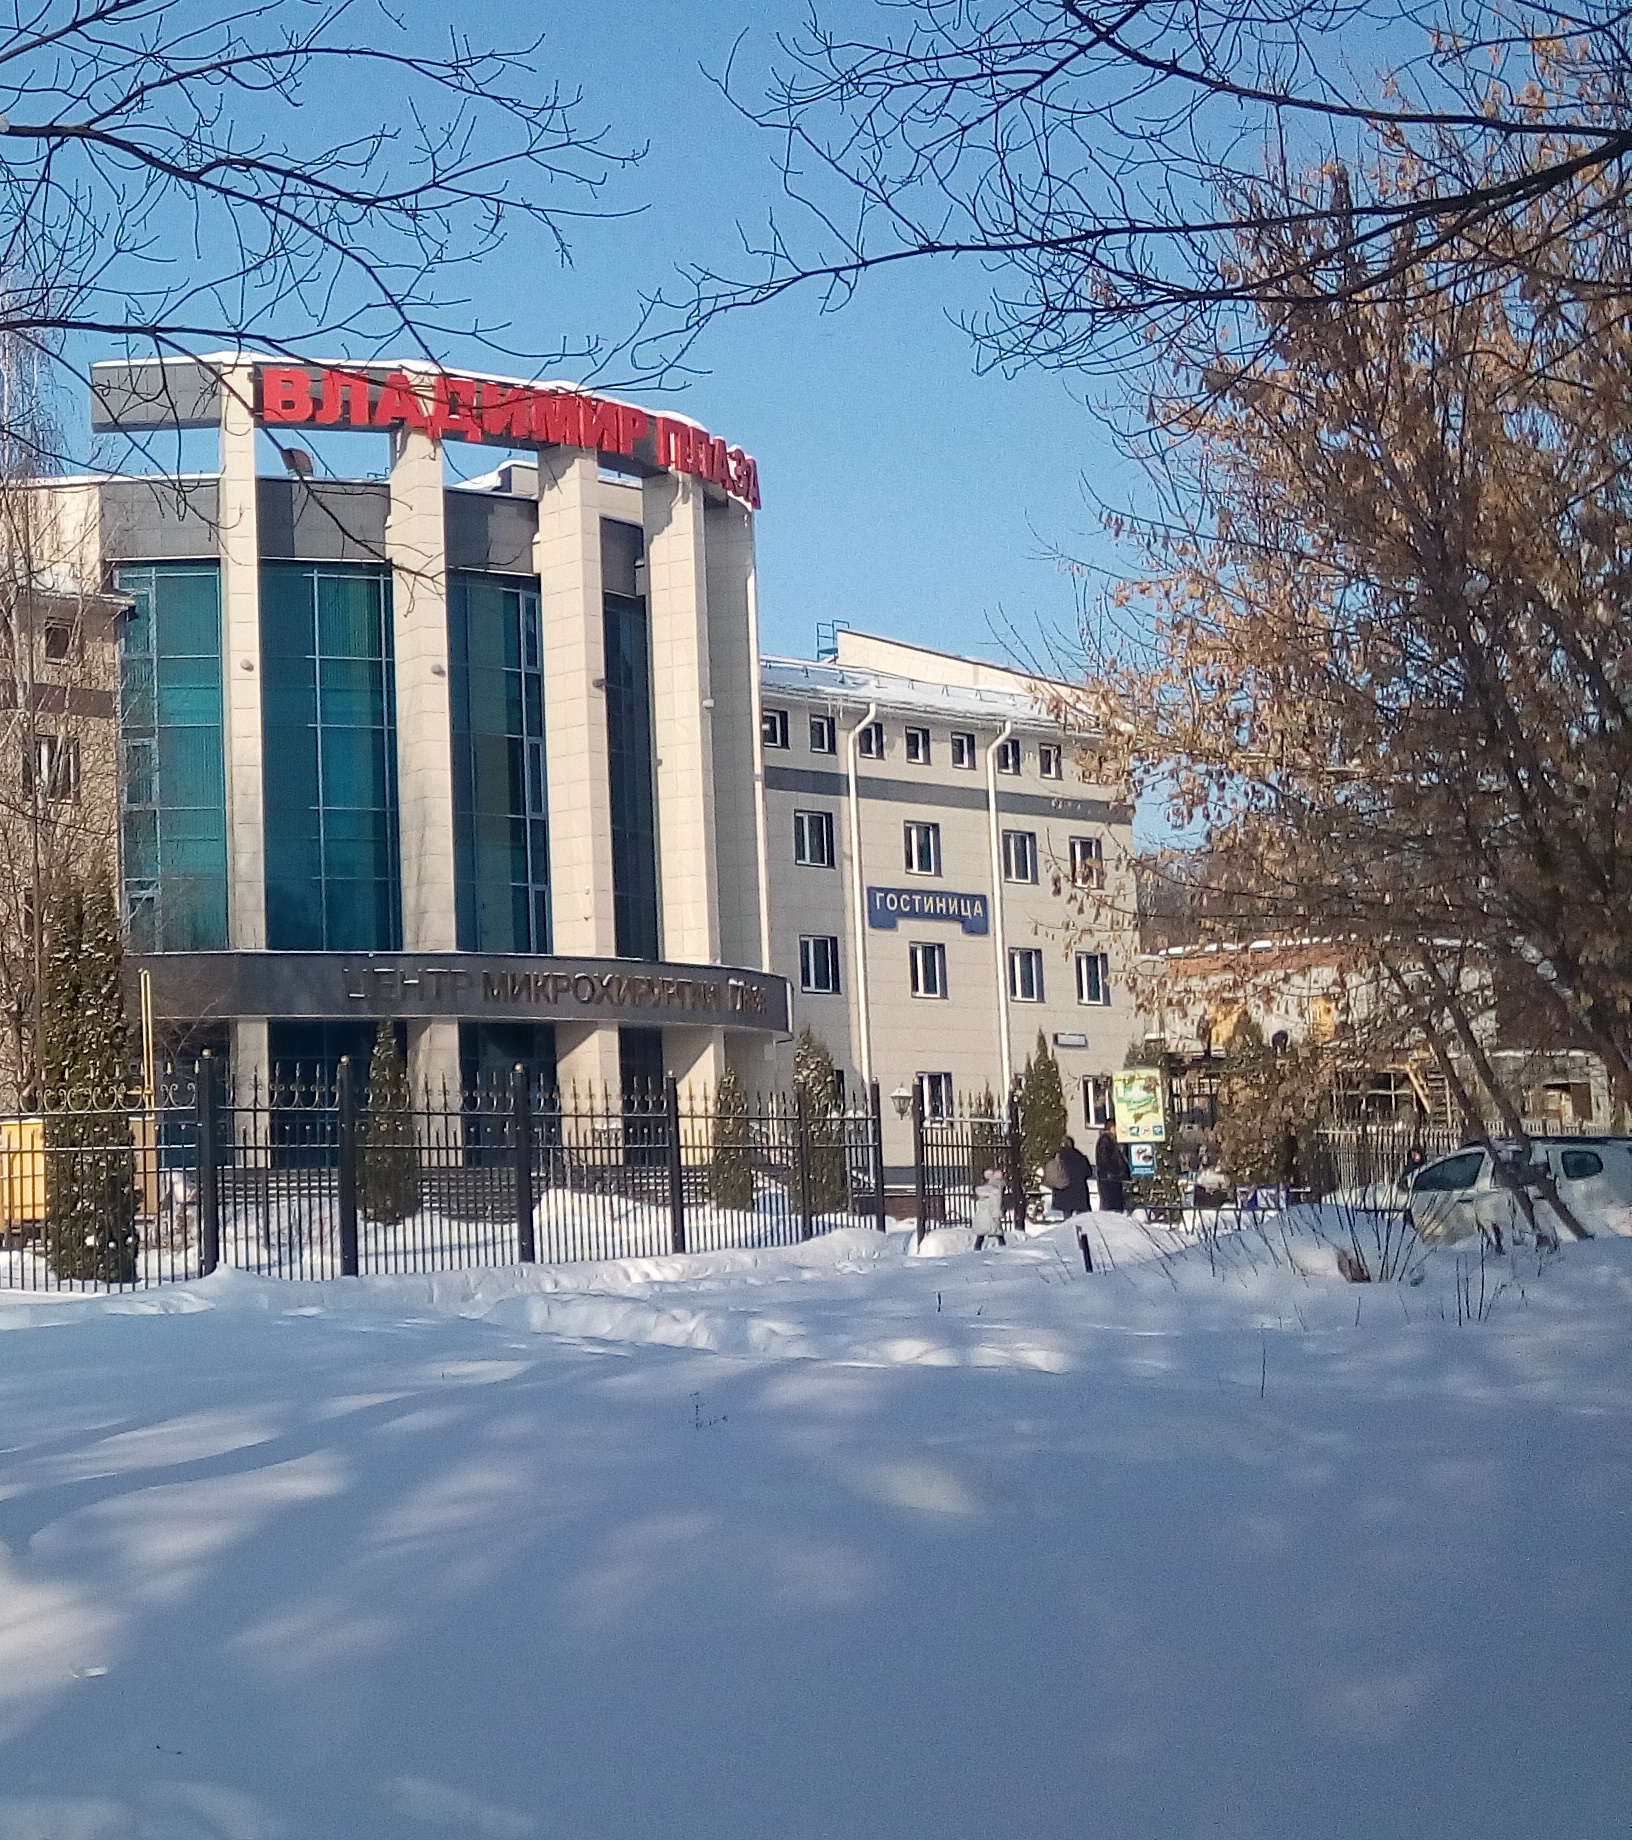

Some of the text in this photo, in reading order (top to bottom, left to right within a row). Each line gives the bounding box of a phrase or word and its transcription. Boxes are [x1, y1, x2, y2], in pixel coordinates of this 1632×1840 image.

[263, 367, 762, 510] ВЛАДИМИР ПЛАЗА
[875, 891, 984, 919] ГОСТИНИЦА
[342, 967, 473, 1005] ЦЕНТР
